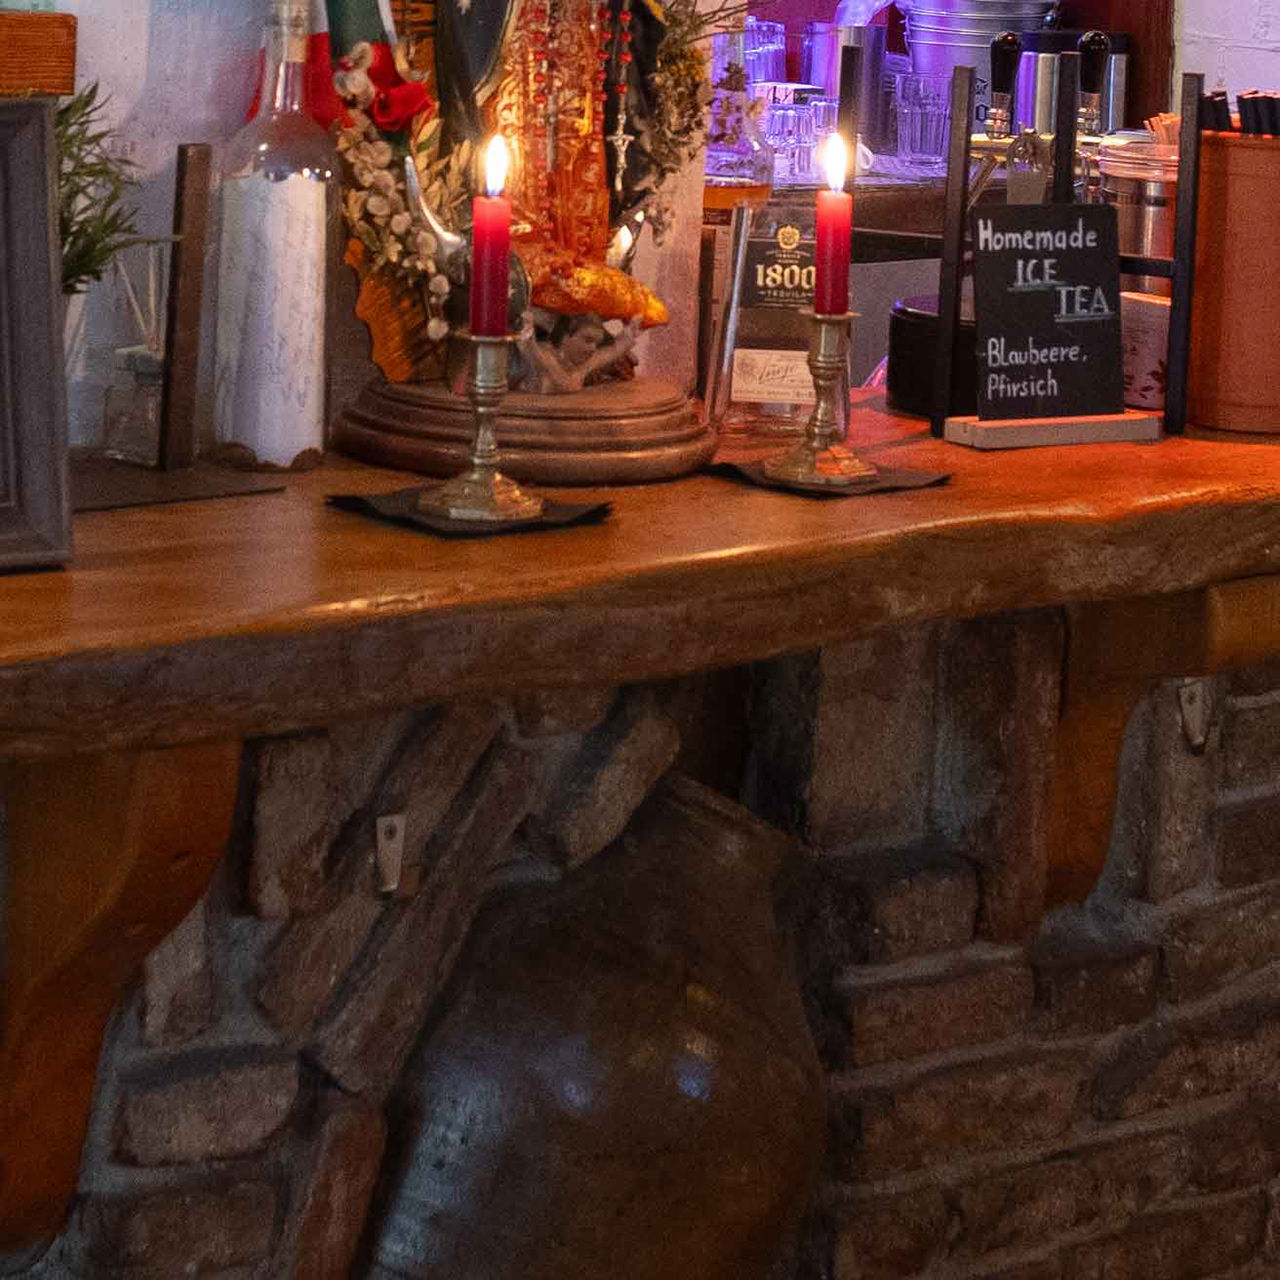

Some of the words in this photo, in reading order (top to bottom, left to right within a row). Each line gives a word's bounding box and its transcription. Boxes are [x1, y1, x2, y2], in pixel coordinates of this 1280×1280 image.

[978, 217, 1098, 251] Homemade
[755, 264, 817, 289] 1800
[1016, 258, 1058, 285] ICE
[1055, 285, 1109, 317] TEA
[987, 368, 1058, 400] Pfirsich
